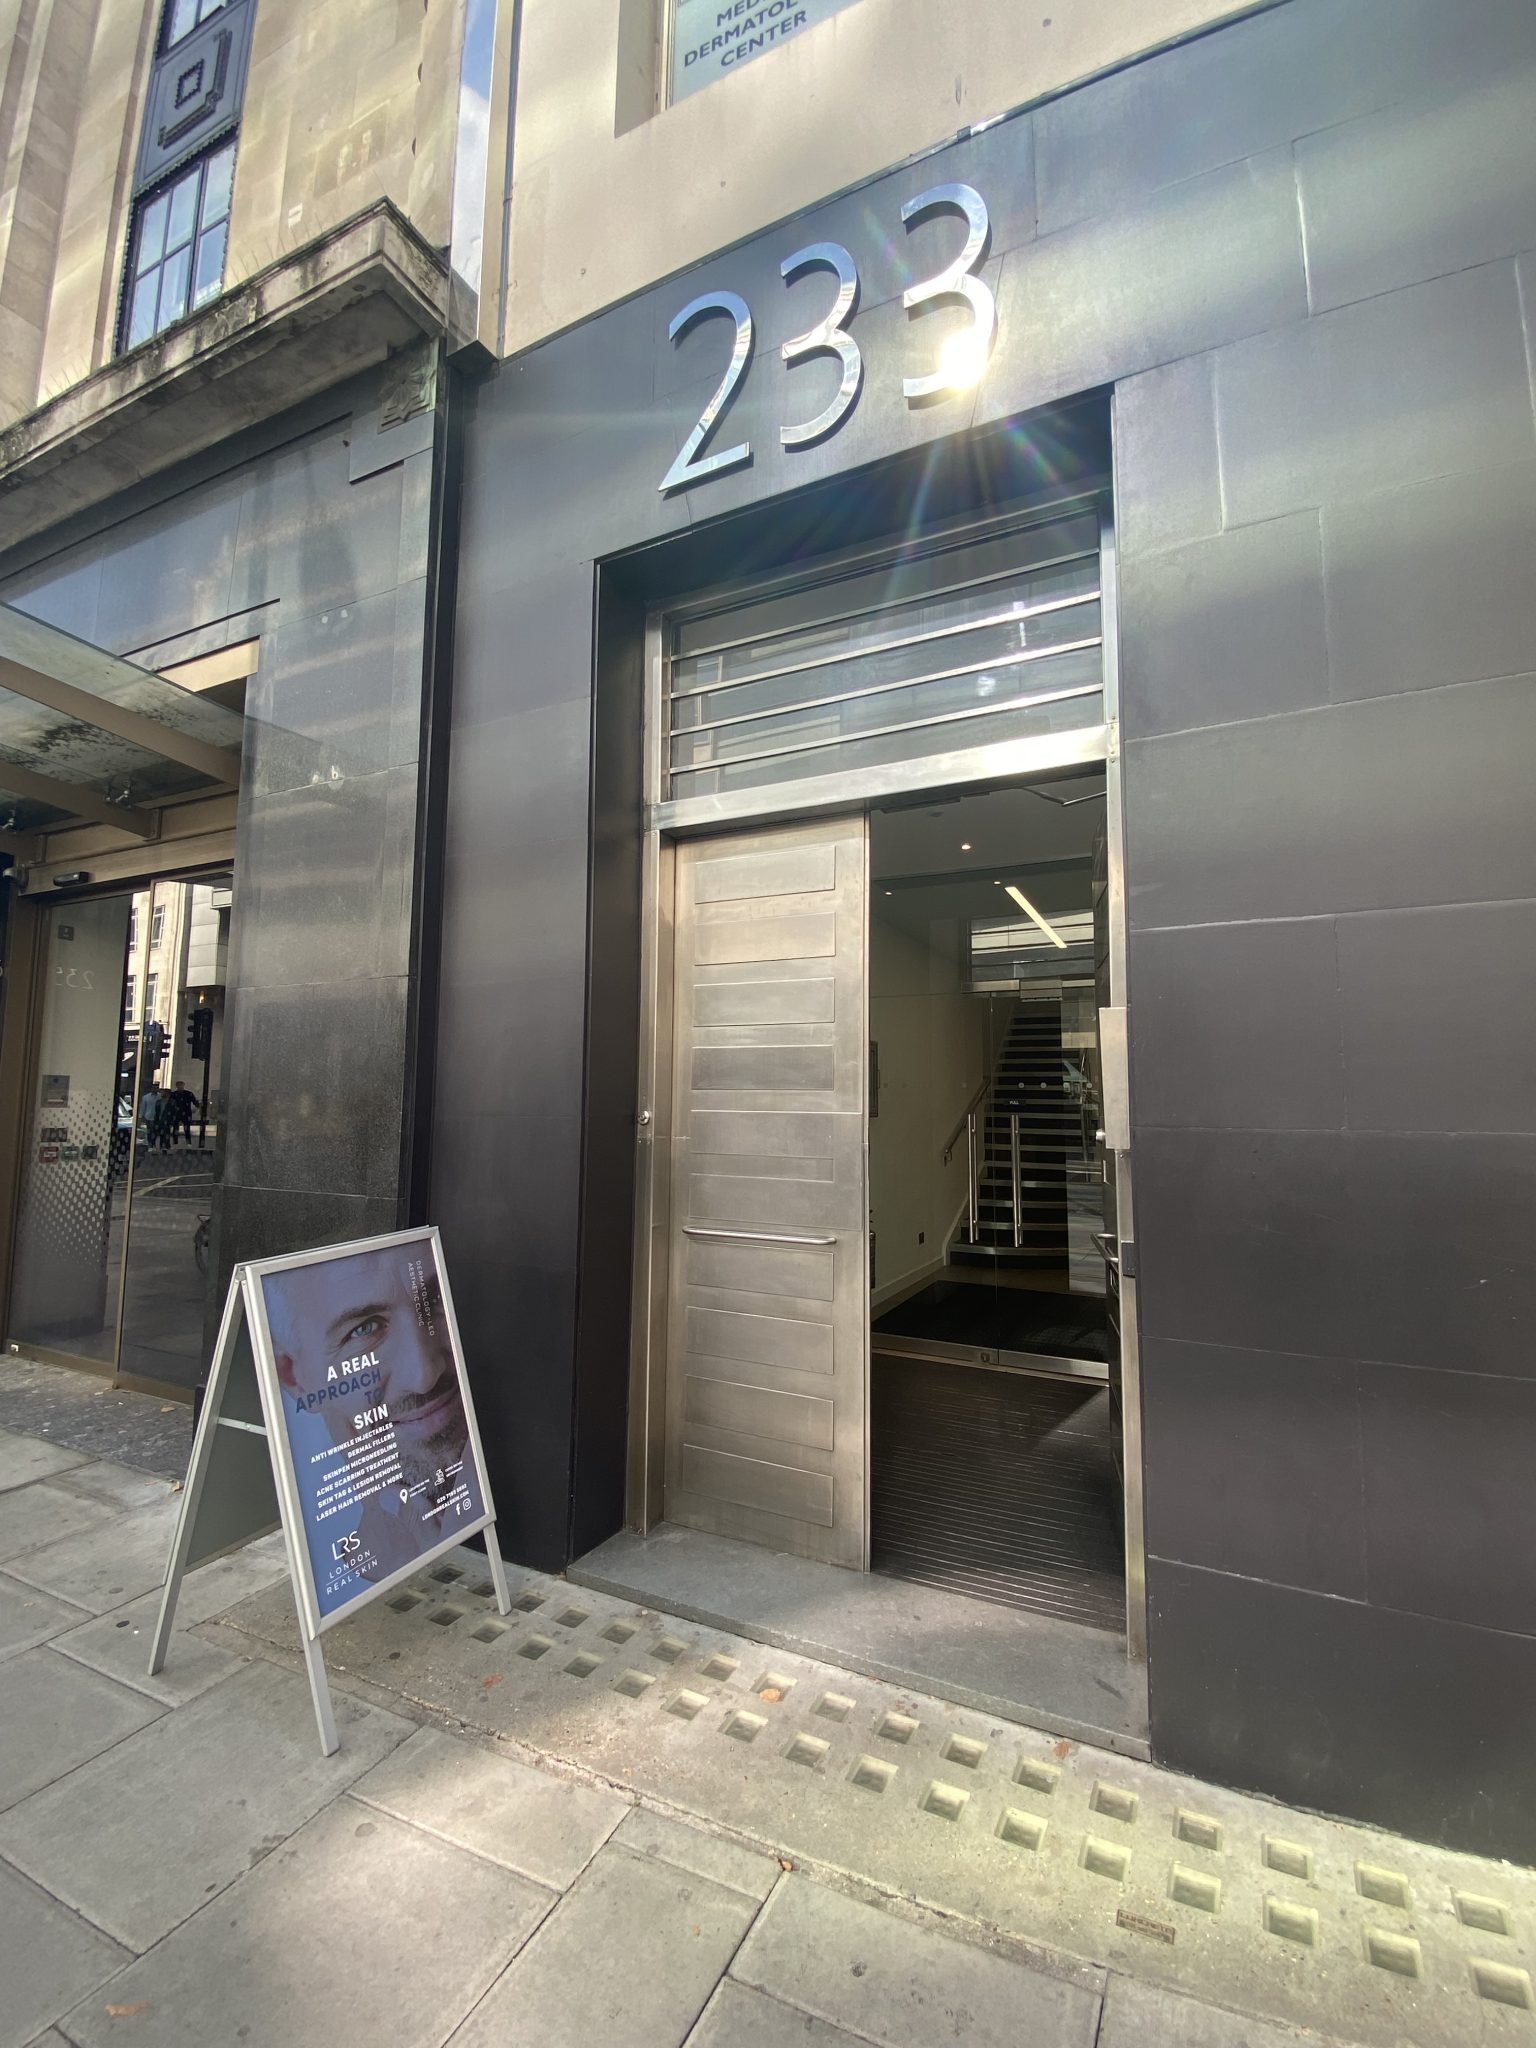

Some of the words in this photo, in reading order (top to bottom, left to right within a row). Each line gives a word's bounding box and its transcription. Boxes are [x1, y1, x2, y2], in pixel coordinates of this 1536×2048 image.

[716, 0, 762, 27] MED
[720, 10, 807, 67] CENTER
[658, 182, 996, 493] 233
[407, 1262, 420, 1302] AESTHETIC
[415, 1302, 425, 1327] CLINIC
[327, 1365, 338, 1382] A
[341, 1351, 379, 1376] REAL
[296, 1368, 381, 1414] APPROACH
[364, 1386, 386, 1405] TO
[354, 1403, 389, 1430] SKIN
[310, 1452, 327, 1464] ANTI
[328, 1439, 355, 1456] WRINKLE
[354, 1422, 393, 1444] INJECTABLES
[323, 1464, 351, 1482] SKINPEN
[351, 1442, 397, 1469] MICRONEEDLING
[347, 1443, 373, 1459] DERMAL
[372, 1432, 396, 1448] FILLERS
[316, 1485, 334, 1498] ACNE
[334, 1469, 366, 1488] SCARRING
[366, 1452, 399, 1473] TREATMENT
[317, 1496, 334, 1509] SKIN
[334, 1490, 347, 1501] TAG
[352, 1476, 375, 1491] LESION
[375, 1462, 401, 1480] REMOVAL
[316, 1506, 337, 1522] LASER
[338, 1498, 354, 1511] HAIR
[354, 1484, 382, 1502] REMOVAL
[387, 1472, 404, 1486] MORE
[329, 1550, 371, 1579] LONDON
[332, 1531, 361, 1560] LRS
[326, 1575, 353, 1595] REAL
[355, 1559, 378, 1577] SKIN
